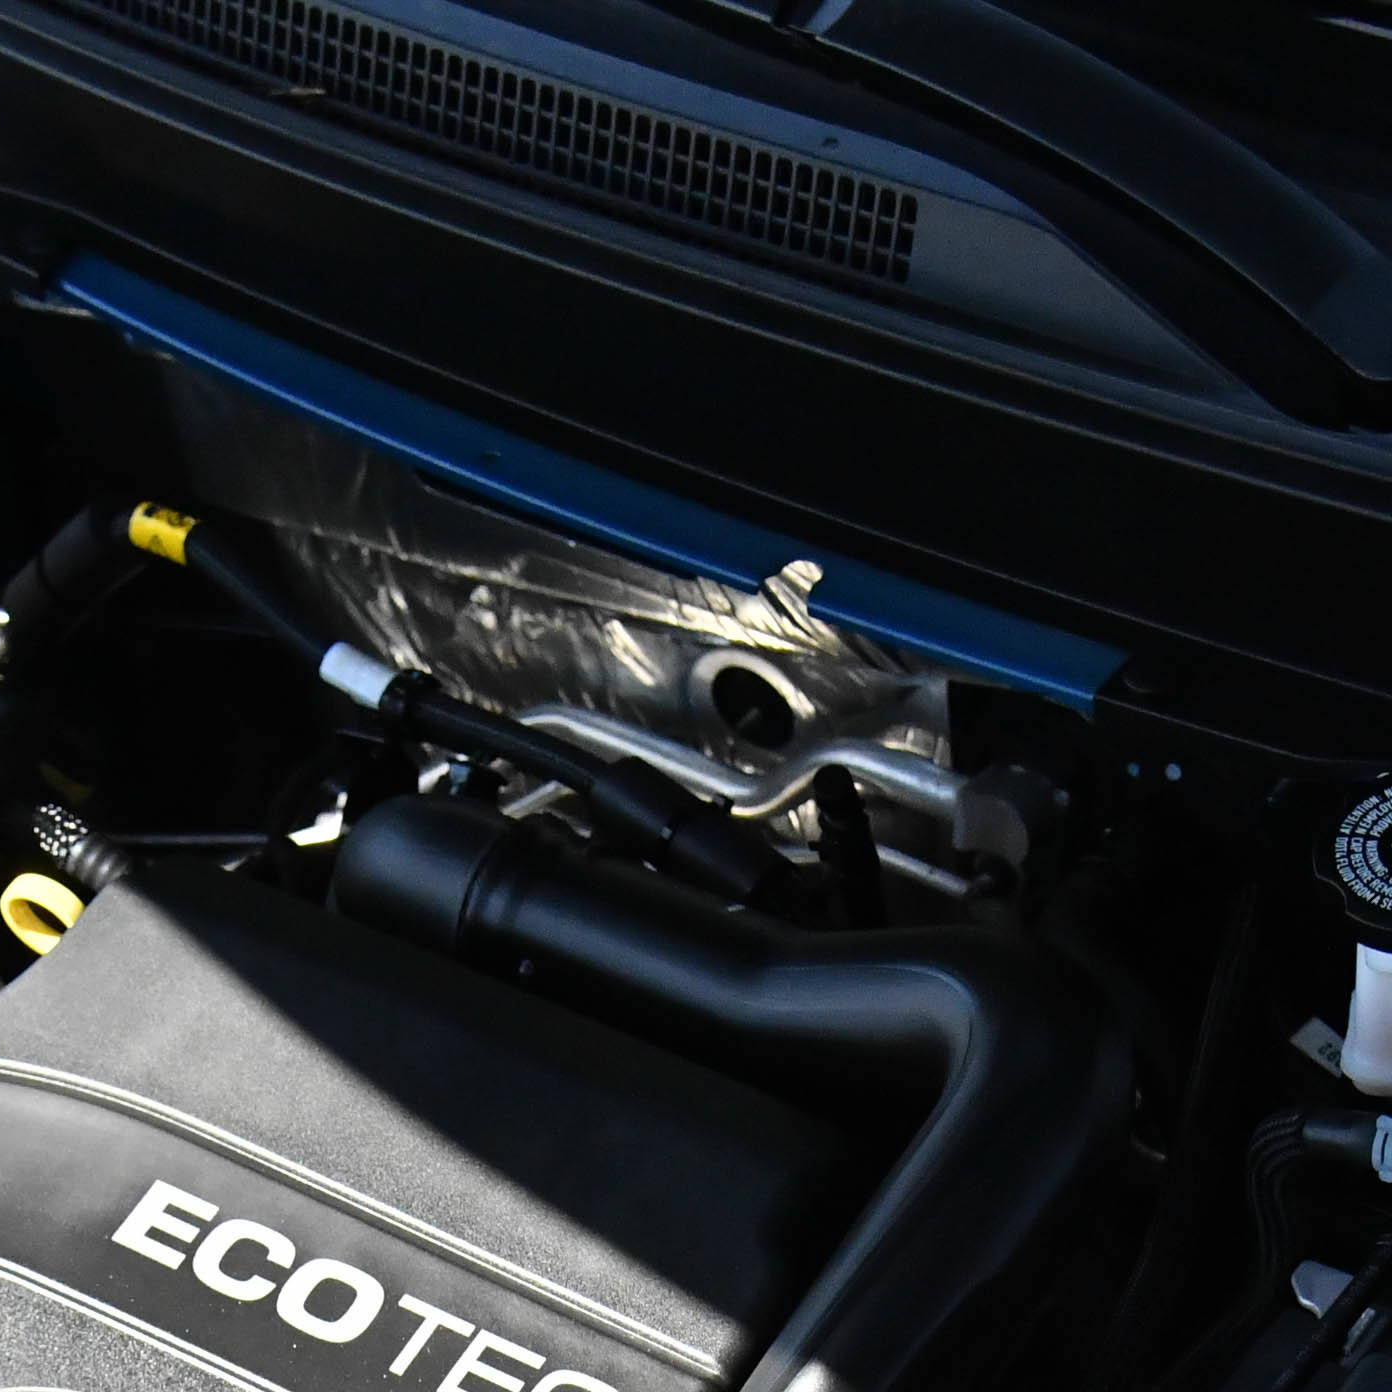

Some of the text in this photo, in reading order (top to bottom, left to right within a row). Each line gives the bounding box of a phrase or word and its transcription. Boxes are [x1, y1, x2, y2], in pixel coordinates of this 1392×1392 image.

[1350, 837, 1364, 852] CAP
[1350, 853, 1375, 884] BEFORE
[1348, 878, 1376, 900] FROM
[1371, 895, 1379, 905] A
